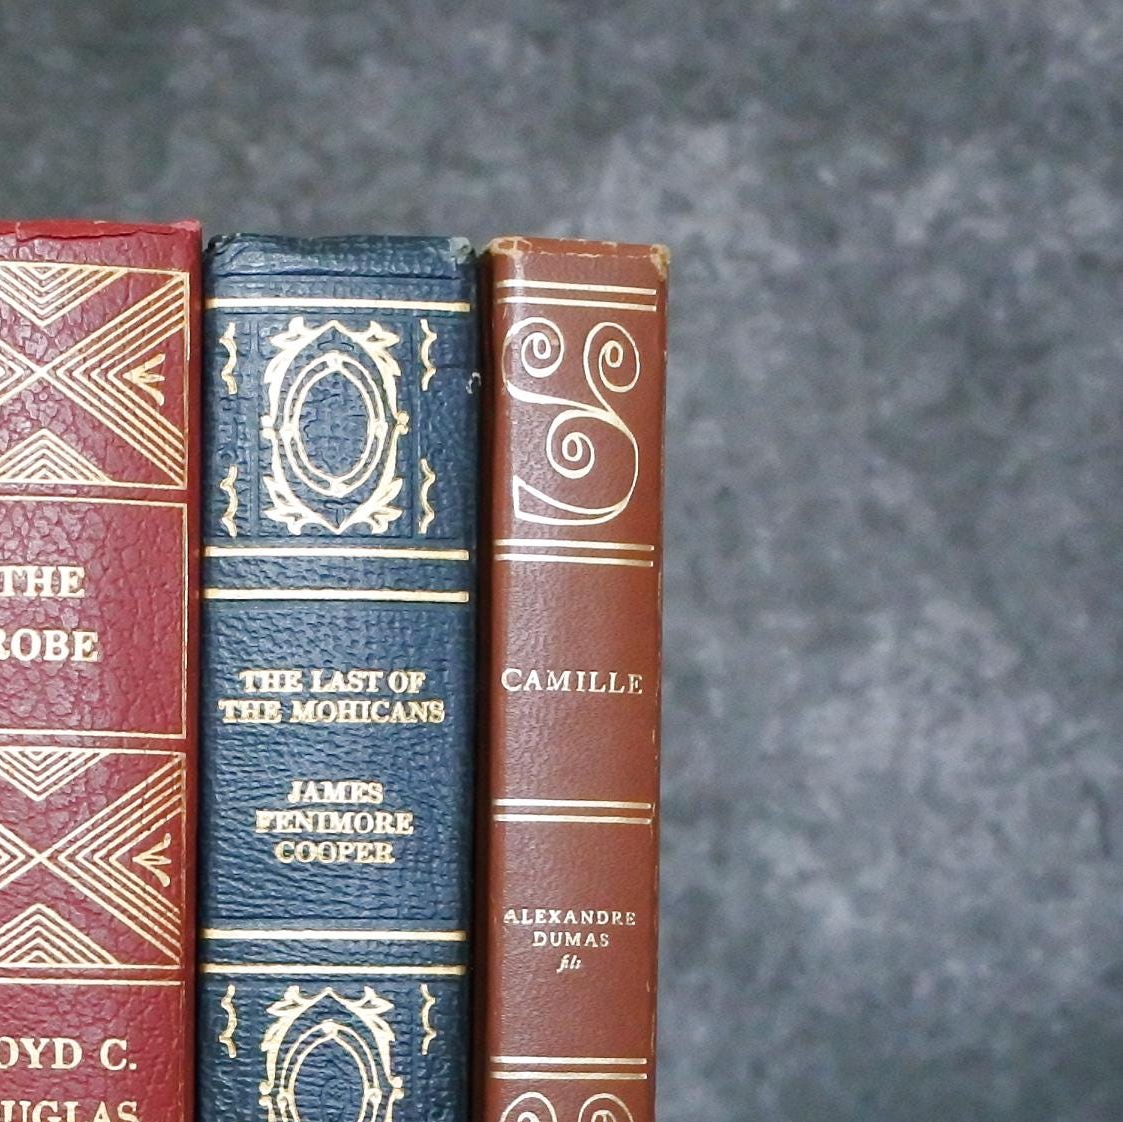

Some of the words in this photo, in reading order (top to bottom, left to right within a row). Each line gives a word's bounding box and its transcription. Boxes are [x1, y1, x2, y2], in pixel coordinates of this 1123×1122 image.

[239, 670, 303, 693] THE
[312, 670, 383, 693] LAST
[388, 671, 427, 694] OF
[500, 668, 644, 695] CAMILLE
[218, 699, 283, 723] THE
[291, 700, 446, 723] MOHICANS
[287, 780, 384, 803] JAMES
[255, 810, 414, 834] FENIMORE
[275, 841, 395, 864] COOPER
[503, 909, 636, 926] ALEXANDRE
[532, 931, 609, 947] DUMAS
[99, 1037, 137, 1071] C.
